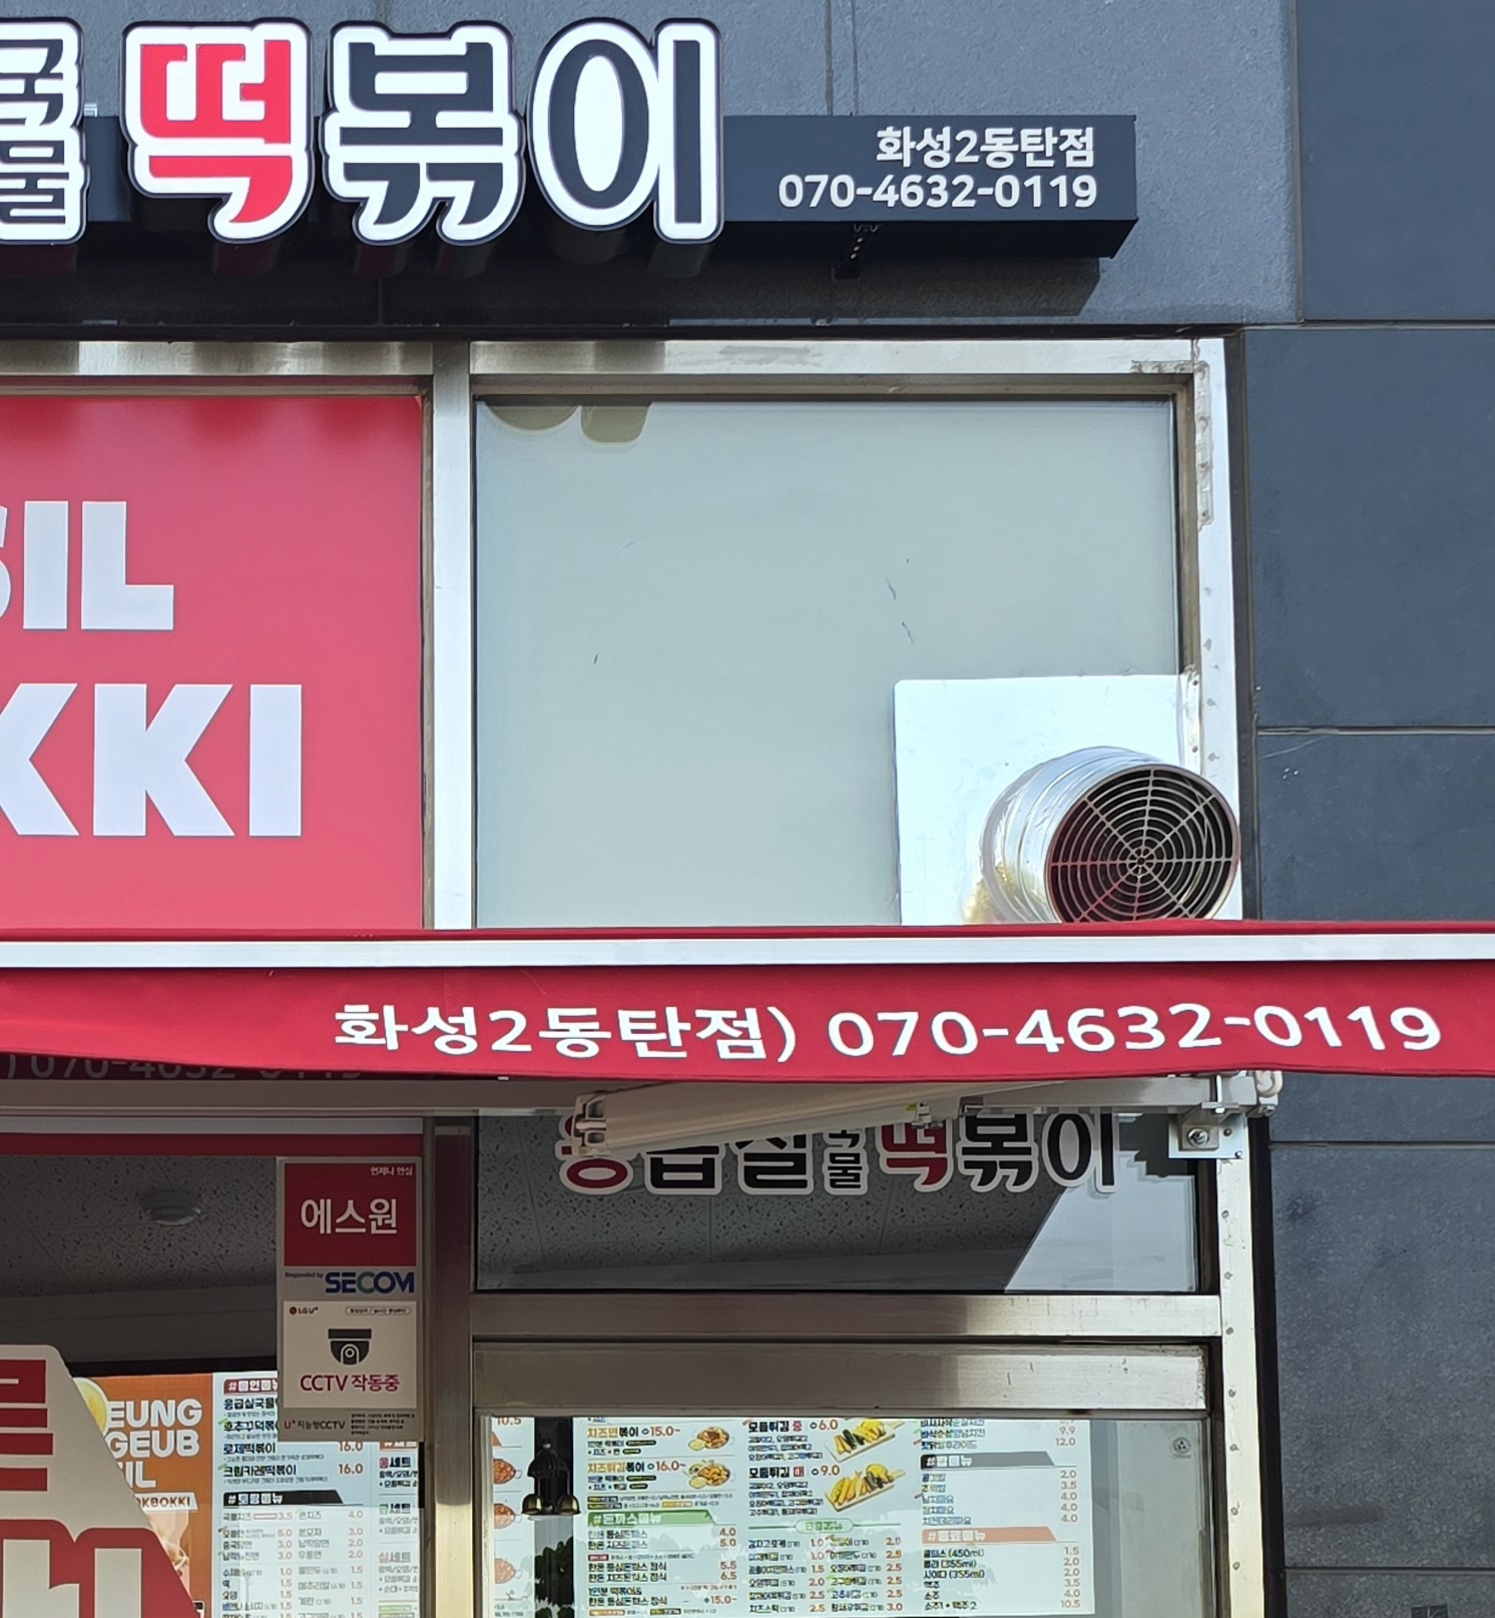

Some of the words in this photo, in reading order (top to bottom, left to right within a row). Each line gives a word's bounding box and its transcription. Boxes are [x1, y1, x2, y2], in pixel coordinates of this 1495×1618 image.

[876, 126, 1095, 168] 화성2동탄점
[777, 174, 1098, 209] 070-4632-0119
[334, 1003, 796, 1063] 화성2동탄점)
[827, 1002, 1442, 1058] 070-4632-0119
[300, 1198, 398, 1235] 에스원
[325, 1271, 415, 1294] SECOM
[299, 1374, 348, 1392] CCTV
[351, 1373, 400, 1392] 작동중
[107, 1398, 202, 1428] EUNG
[818, 1419, 839, 1430] 6.0
[1059, 1427, 1076, 1435] 9.9
[105, 1428, 200, 1459] GEUB
[1056, 1438, 1076, 1446] 12.0
[338, 1463, 364, 1475] 16.0
[820, 1465, 840, 1476] 9.0
[117, 1460, 157, 1488] IL
[1060, 1470, 1077, 1479] 2.0
[1060, 1481, 1077, 1490] 3.5
[1060, 1492, 1078, 1501] 4.0
[1060, 1503, 1078, 1512] 4.0
[347, 1510, 364, 1518] 4.0
[1061, 1514, 1078, 1523] 4.0
[719, 1528, 736, 1537] 4.0
[347, 1539, 364, 1548] 2.0
[719, 1538, 736, 1547] 5.0
[347, 1550, 364, 1559] 2.0
[1064, 1547, 1079, 1555] 1.5
[720, 1561, 737, 1570] 5.5
[1063, 1557, 1080, 1566] 2.0
[811, 1564, 825, 1573] 1.5
[886, 1564, 902, 1572] 2.5
[1063, 1568, 1080, 1577] 2.0
[720, 1571, 737, 1580] 6.5
[808, 1577, 825, 1586] 2.0
[887, 1577, 902, 1585] 2.5
[1064, 1578, 1080, 1587] 3.5
[809, 1591, 825, 1599] 2.5
[887, 1590, 903, 1598] 2.5
[1064, 1589, 1081, 1598] 4.0
[810, 1604, 826, 1612] 2.5
[886, 1603, 903, 1612] 3.0
[1060, 1600, 1081, 1609] 10.5
